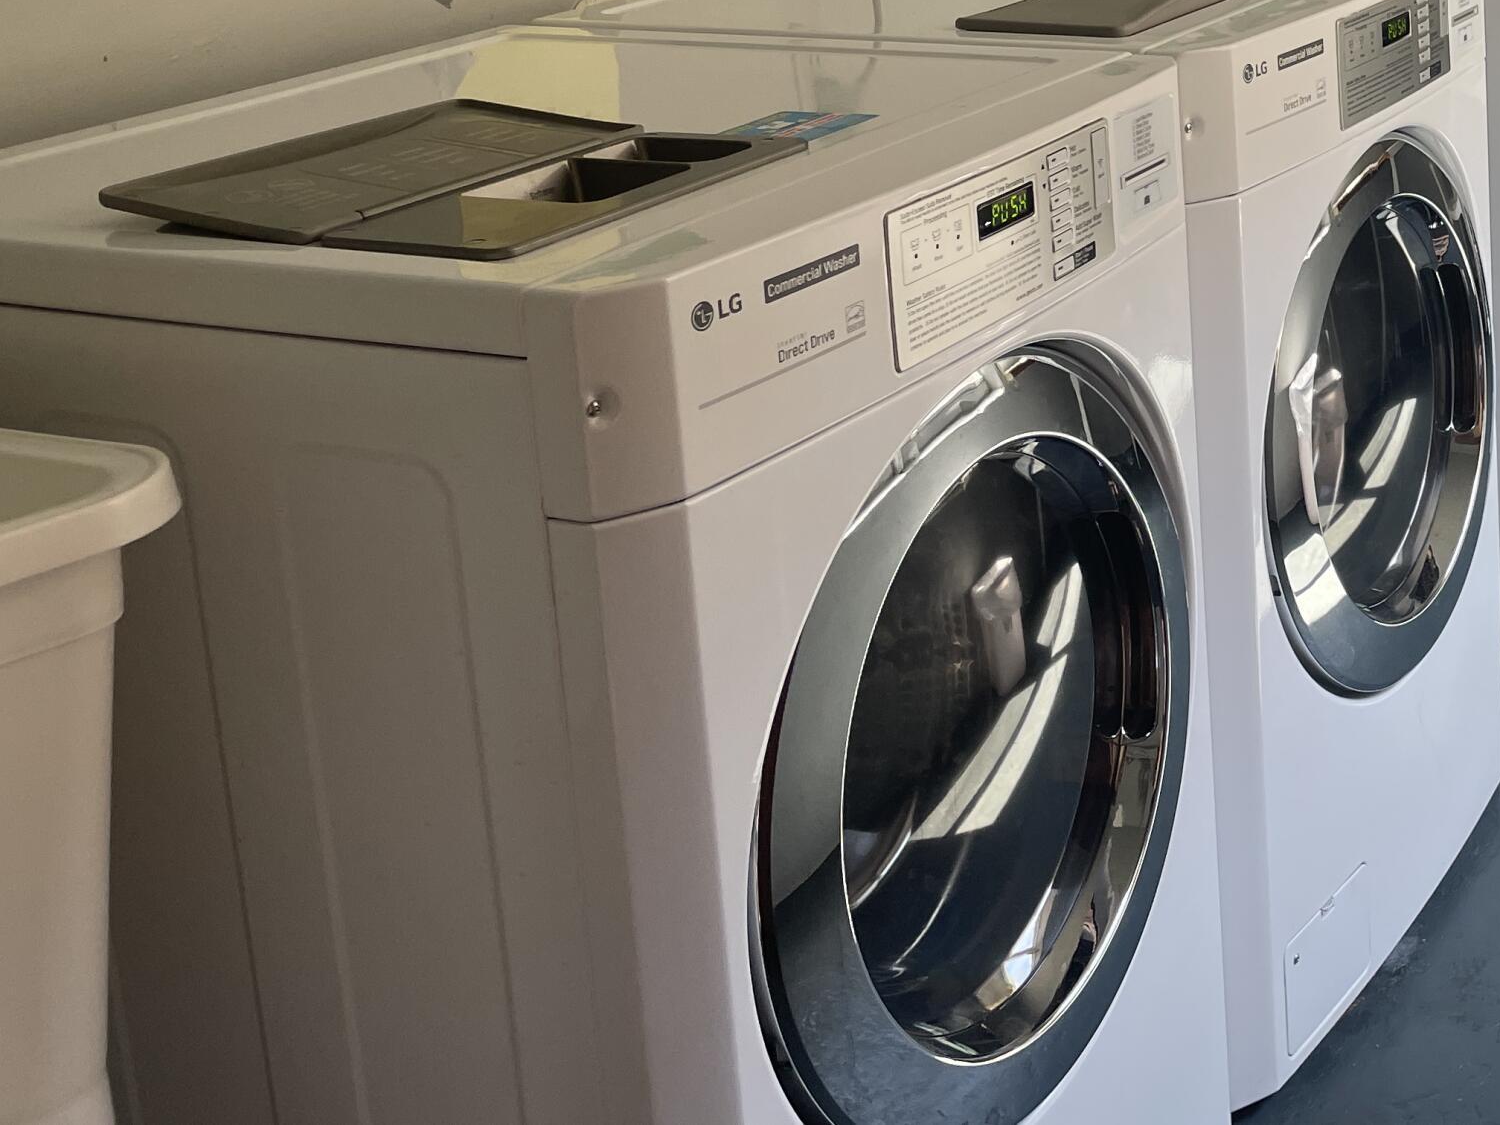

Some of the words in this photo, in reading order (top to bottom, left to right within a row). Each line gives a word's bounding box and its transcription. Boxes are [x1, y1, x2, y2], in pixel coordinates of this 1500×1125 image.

[1255, 61, 1267, 78] LG
[767, 264, 822, 297] Commercial
[823, 251, 857, 274] Washer
[717, 292, 743, 320] LG
[778, 341, 809, 364] Direct
[810, 329, 836, 349] Drive
